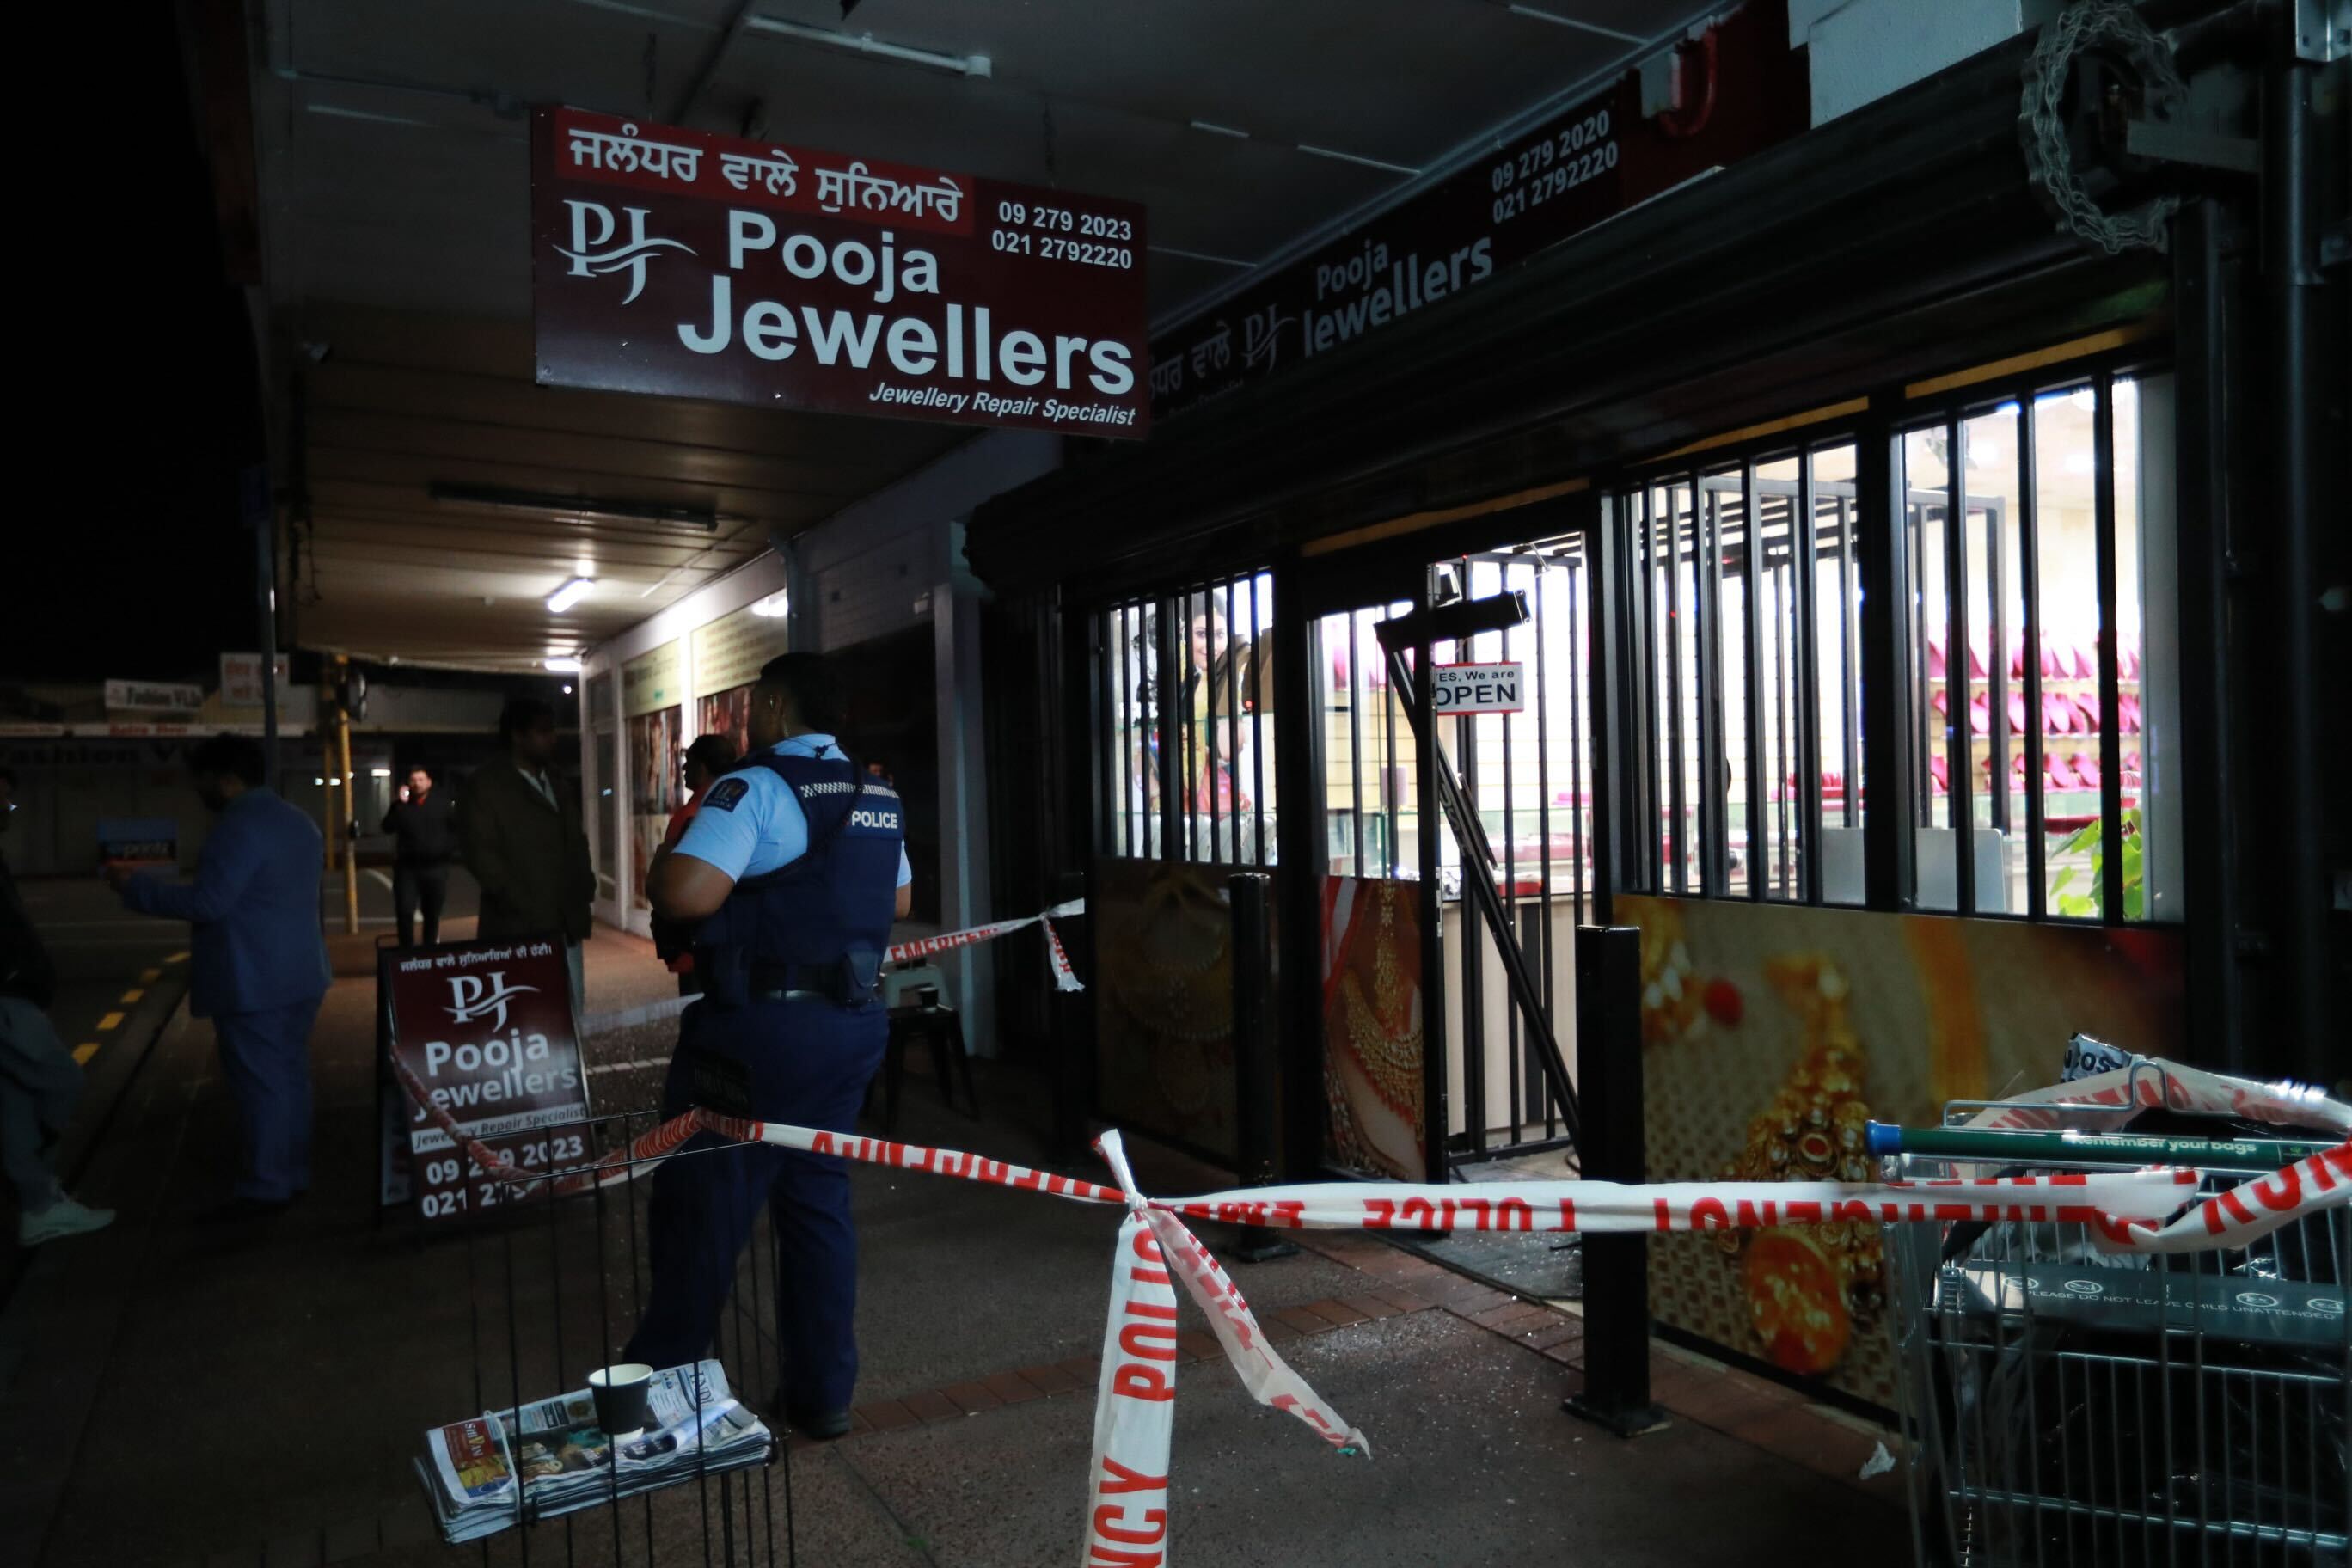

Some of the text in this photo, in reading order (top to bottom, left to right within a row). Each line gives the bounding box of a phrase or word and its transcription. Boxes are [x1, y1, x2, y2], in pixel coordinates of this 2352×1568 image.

[568, 123, 963, 223] ਜਲੰਧਰ ਵਾਲੇ ਸੁਨਿਆਰੇ
[1491, 109, 1610, 193] 09 279 2020
[1492, 140, 1619, 224] 021 2792220
[999, 201, 1132, 241] 09 279 2023
[727, 209, 941, 303] Pooja
[991, 230, 1133, 270] 021 2792220
[1316, 239, 1388, 302] Pooja
[677, 275, 1136, 395] Jewellers
[869, 381, 1136, 426] Jewellery Repair Specialist
[1436, 684, 1516, 706] OPEN
[1439, 672, 1461, 682] ES,
[1465, 671, 1486, 680] We
[851, 810, 898, 829] POLICE
[425, 1027, 550, 1076] Pooja
[481, 1119, 521, 1134] Repair
[525, 1107, 586, 1128] Specialist
[426, 1135, 585, 1185] 09 29 2023
[2073, 1135, 2257, 1155] Remember your bags
[421, 1186, 467, 1217] 021
[1112, 1210, 1176, 1402] POLIC
[2232, 1306, 2336, 1320] UNATTENDED
